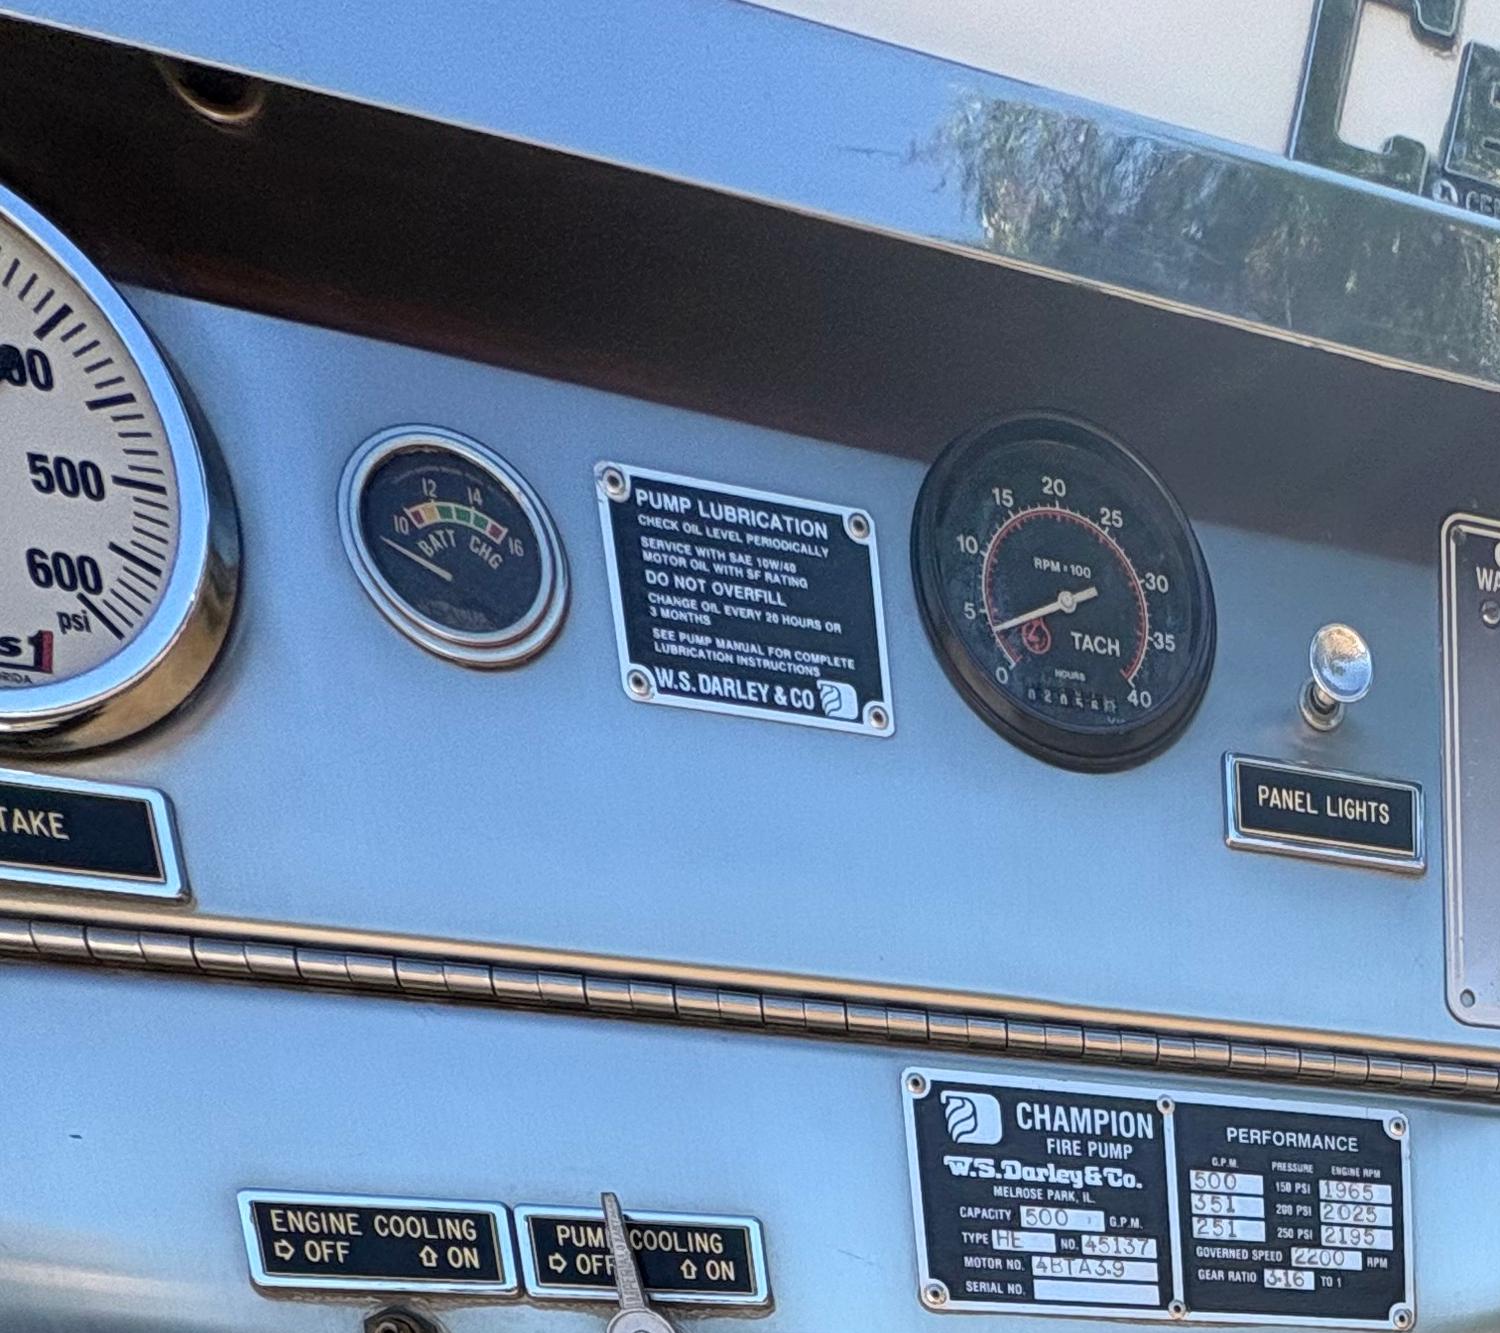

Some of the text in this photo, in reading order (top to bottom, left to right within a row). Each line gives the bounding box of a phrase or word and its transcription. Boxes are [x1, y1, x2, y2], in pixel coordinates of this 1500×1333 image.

[28, 452, 103, 501] 500
[422, 478, 437, 498] 12
[1041, 477, 1066, 496] 20
[992, 488, 1013, 506] 15
[635, 489, 828, 539] PUMP LUBRICATION
[1100, 508, 1123, 528] 25
[417, 529, 455, 558] BATT
[638, 514, 828, 558] CHECK OIL LEVEL PERIODICALLY
[957, 535, 978, 554] 10
[641, 537, 752, 566] SERVICE WITH SAE
[26, 549, 101, 595] 600
[642, 551, 808, 589] MOTOR OIL WITH RATING
[1034, 557, 1061, 573] RPM
[645, 570, 787, 607] DO NOT OVERFILL
[1145, 574, 1169, 592] 30
[57, 611, 91, 634] psi
[648, 592, 842, 634] CHANGE OIL EVERY HOURS OR
[660, 609, 711, 626] MONTHS
[964, 602, 976, 619] 5
[652, 628, 855, 670] SEE PUMP MANUAL FOR COMPLETE
[1071, 632, 1120, 656] TACH
[1152, 632, 1175, 651] 35
[654, 642, 820, 678] LUBRICATION INSTRUCTIONS
[654, 667, 814, 710] W.S. DARLEY & CO
[1128, 689, 1151, 708] 40
[1258, 785, 1390, 824] PANEL LIGHTS
[1016, 1102, 1153, 1139] CHAMPION
[1047, 1138, 1132, 1160] FIRE PUMP
[1227, 1127, 1358, 1152] PERFORMANCE
[1272, 1162, 1381, 1178] PRESSURE RPM
[994, 1186, 1078, 1203] MELROSE PARK,
[1195, 1172, 1374, 1201] 500 PSI 1965
[960, 1206, 1143, 1229] CAPACITY 500 G.P.M.
[1194, 1195, 1377, 1222] 351 PSI 2025
[271, 1209, 477, 1241] ENGINE COOLING
[1197, 1219, 1375, 1245] 251 PSI 2195
[557, 1225, 723, 1254] PUM COOLING
[962, 1232, 989, 1244] TYPE
[1061, 1238, 1078, 1250] NO.
[305, 1241, 480, 1269] OFF ON
[964, 1257, 1002, 1269] MOTOR
[1007, 1259, 1025, 1271] NO.
[1196, 1247, 1387, 1268] GOVERNED SPEED 2200 RPM
[576, 1254, 735, 1281] OFF ON
[1198, 1269, 1224, 1280] GEAR
[1228, 1271, 1256, 1282] RATIO
[1321, 1276, 1332, 1287] TO
[966, 1281, 1025, 1295] SERIAL NO.
